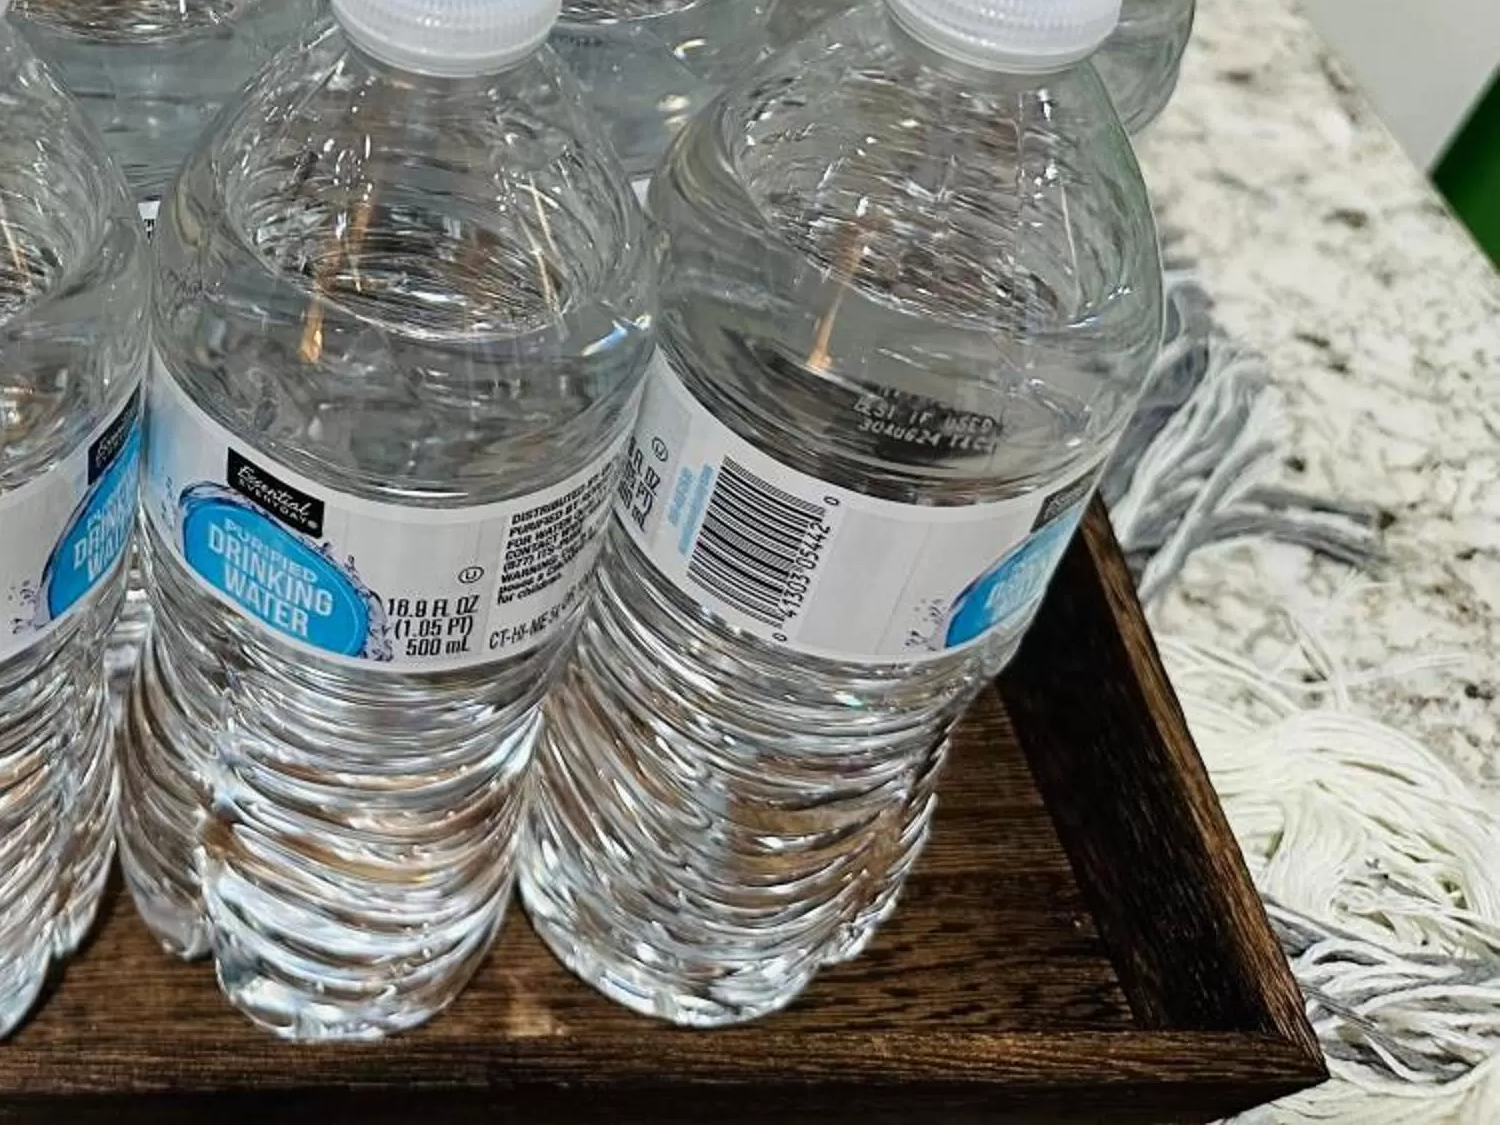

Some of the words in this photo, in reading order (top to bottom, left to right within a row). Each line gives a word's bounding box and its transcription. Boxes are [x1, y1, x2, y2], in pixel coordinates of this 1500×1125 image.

[237, 465, 313, 517] Essential
[238, 478, 308, 524] EVERYDAY
[224, 517, 318, 584] PURIFIED
[506, 534, 533, 550] FOR
[795, 522, 831, 571] 05442
[208, 523, 334, 617] DRINKING
[224, 562, 309, 637] WATER
[387, 597, 428, 618] 16.9
[432, 598, 450, 618] FL
[456, 594, 481, 616] OZ
[394, 618, 443, 640] (1.05
[447, 614, 474, 637] PT)
[405, 637, 442, 656] 500
[445, 635, 471, 655] mL
